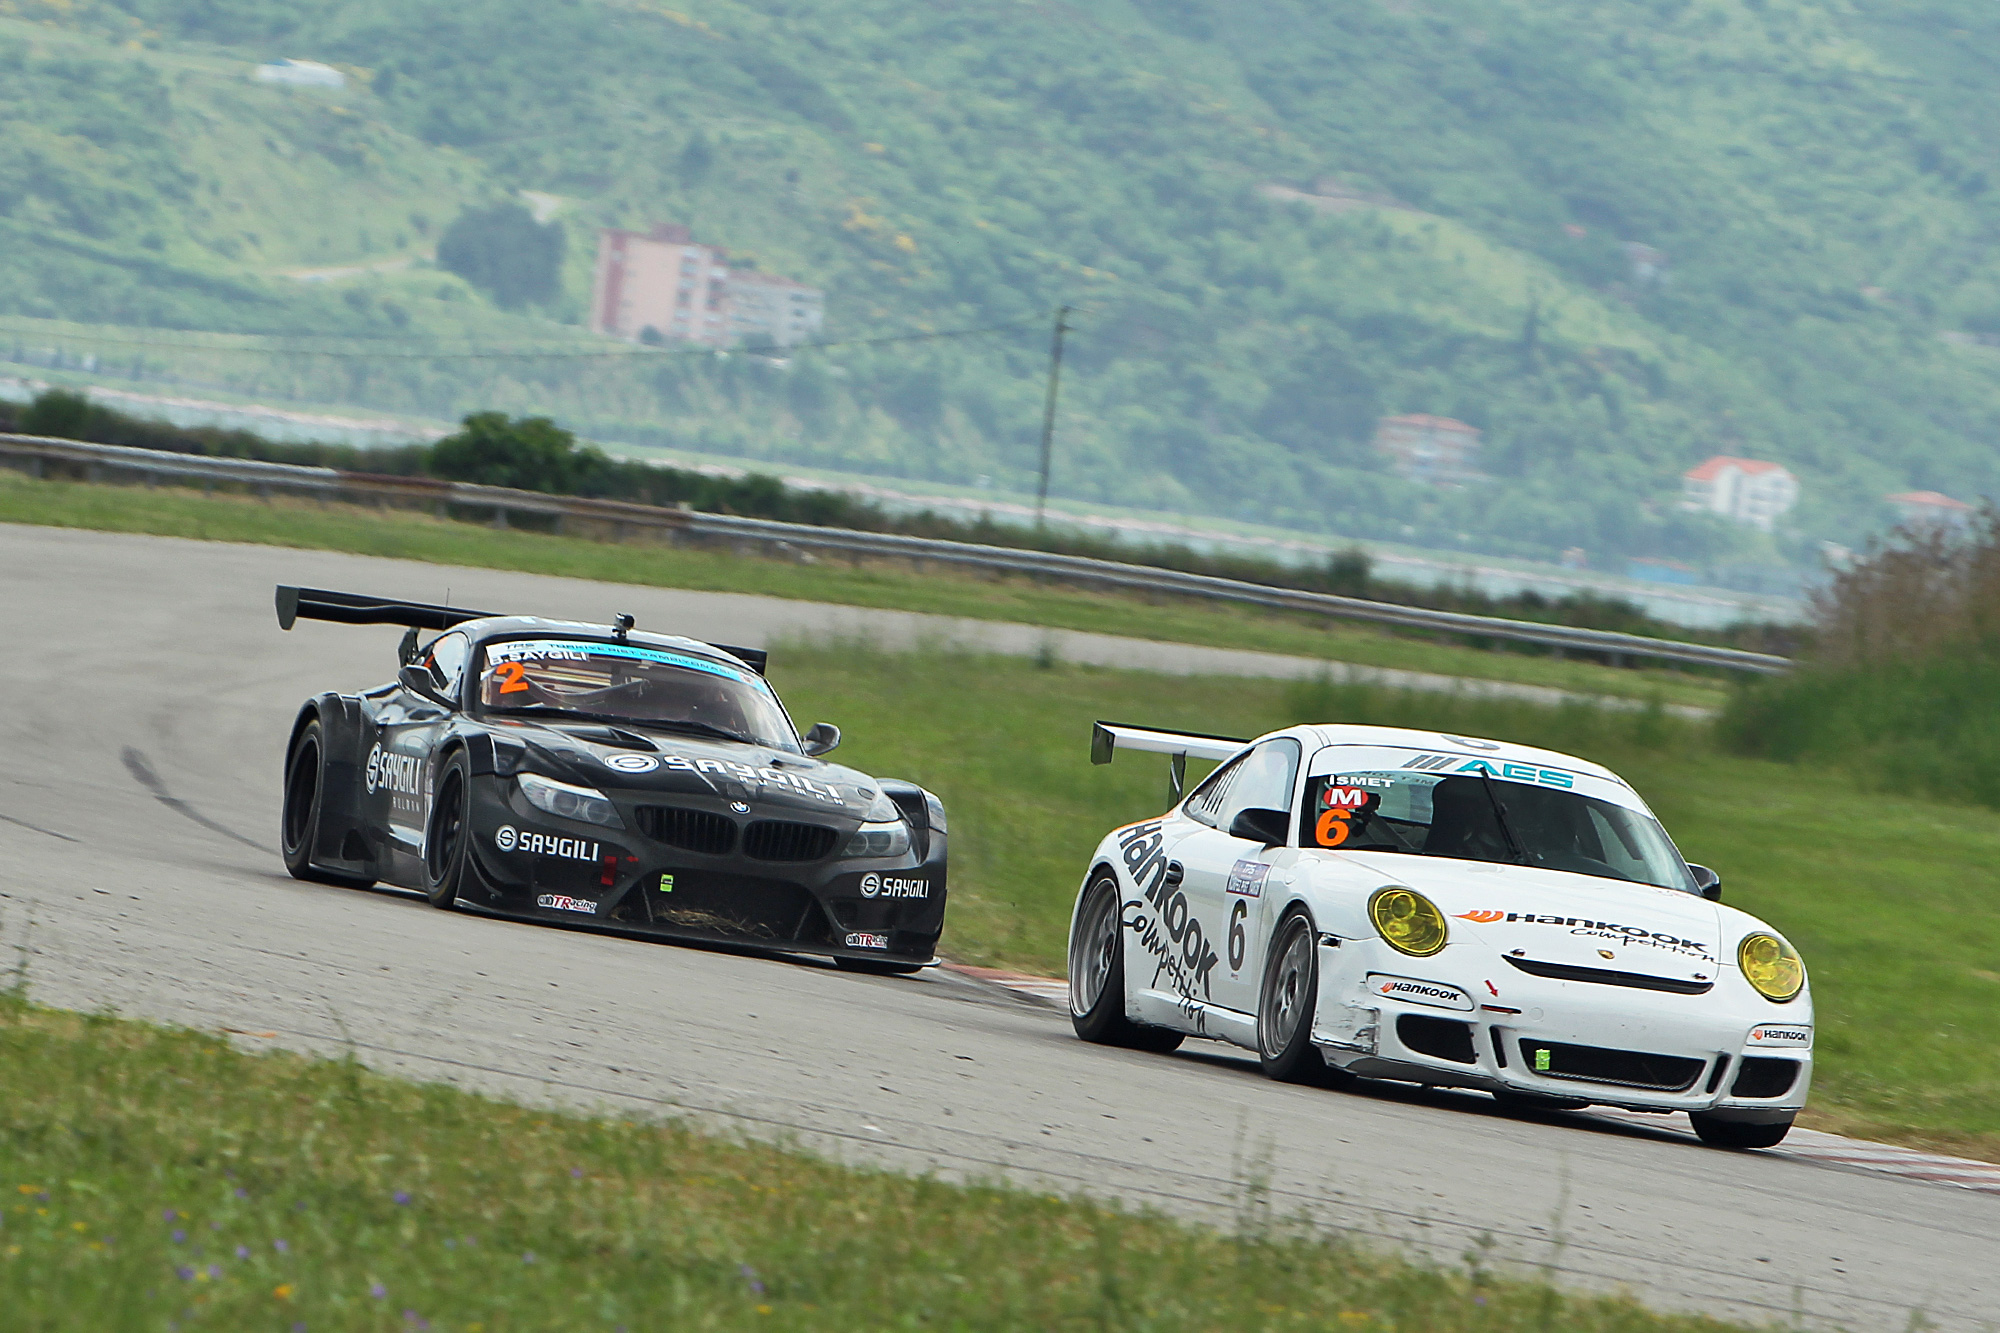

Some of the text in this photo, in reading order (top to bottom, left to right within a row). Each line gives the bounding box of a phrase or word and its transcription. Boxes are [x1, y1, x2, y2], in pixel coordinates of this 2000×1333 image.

[496, 661, 529, 694] 2
[378, 751, 421, 795] SAYGILI
[664, 755, 844, 800] SAYGILI
[1329, 788, 1362, 806] M
[1315, 808, 1352, 847] 6
[518, 832, 599, 862] SAYGILI
[881, 877, 930, 899] SAYGILI
[1228, 898, 1247, 972] 6
